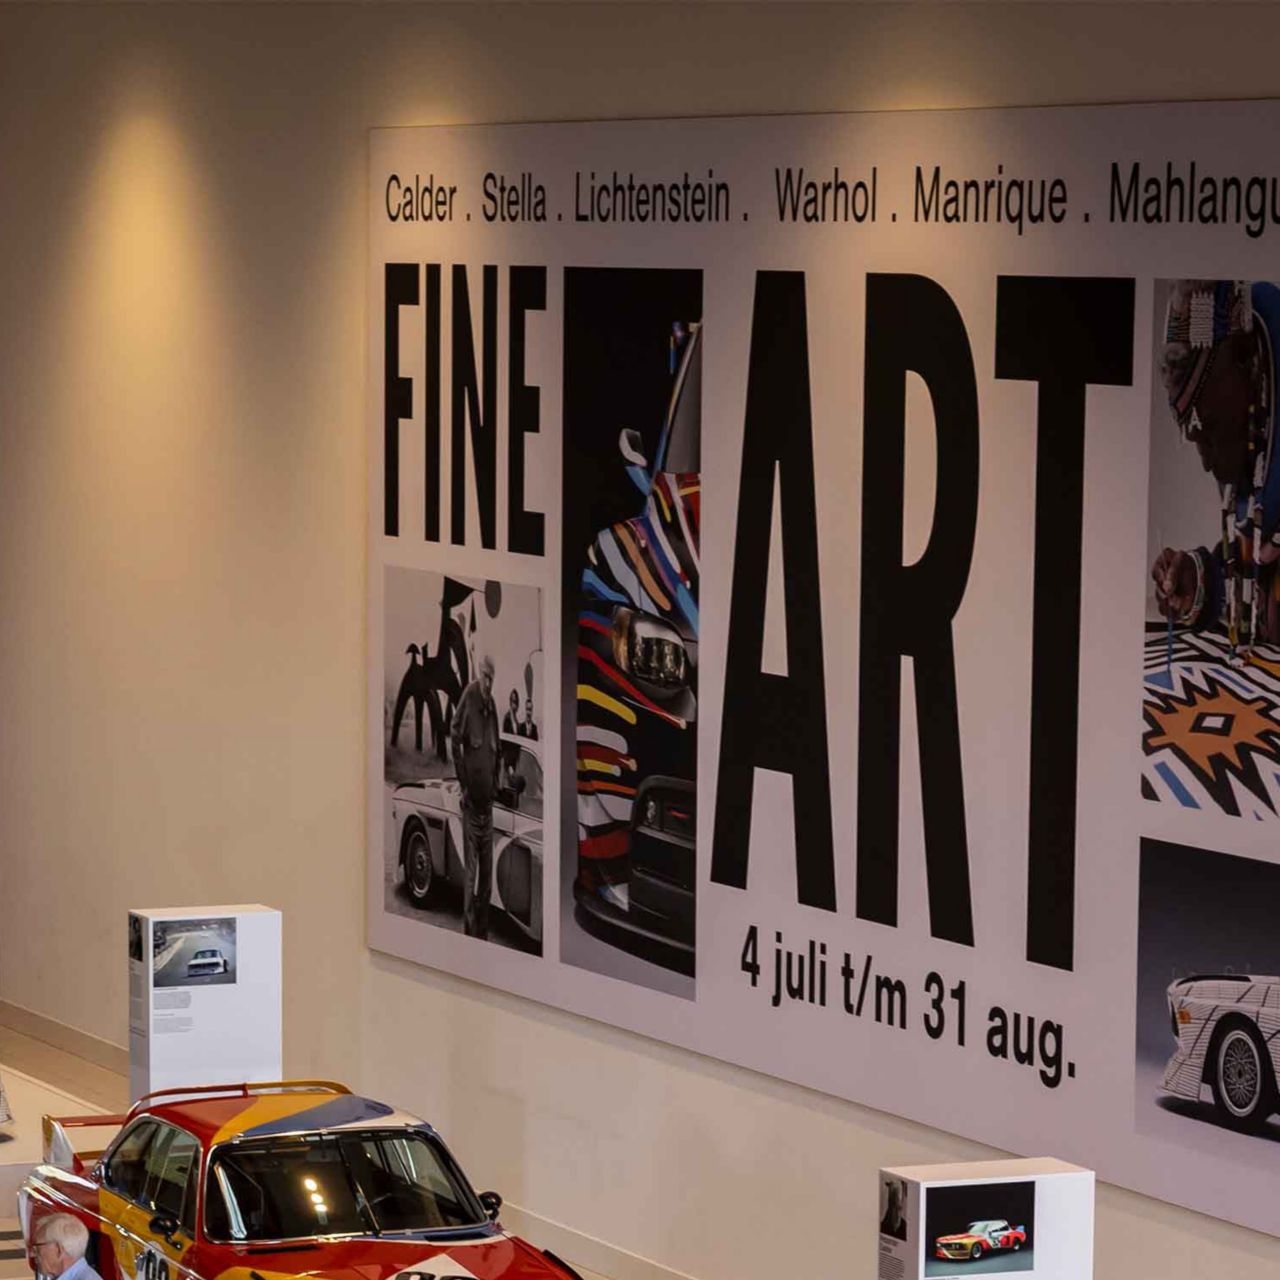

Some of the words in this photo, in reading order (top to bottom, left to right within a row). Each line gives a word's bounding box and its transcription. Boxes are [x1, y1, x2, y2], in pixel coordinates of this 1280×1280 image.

[385, 173, 457, 222] Calder
[482, 172, 547, 223] Stella
[575, 169, 730, 222] Lichtenstein
[775, 166, 877, 223] Warhol
[914, 164, 1068, 236] Manrique
[384, 262, 548, 557] FINE
[710, 269, 1136, 972] ART
[741, 925, 760, 987] 4
[772, 931, 826, 1007] juli
[841, 952, 907, 1030] t/m
[923, 971, 966, 1047] 31
[986, 1006, 1075, 1089] aug.
